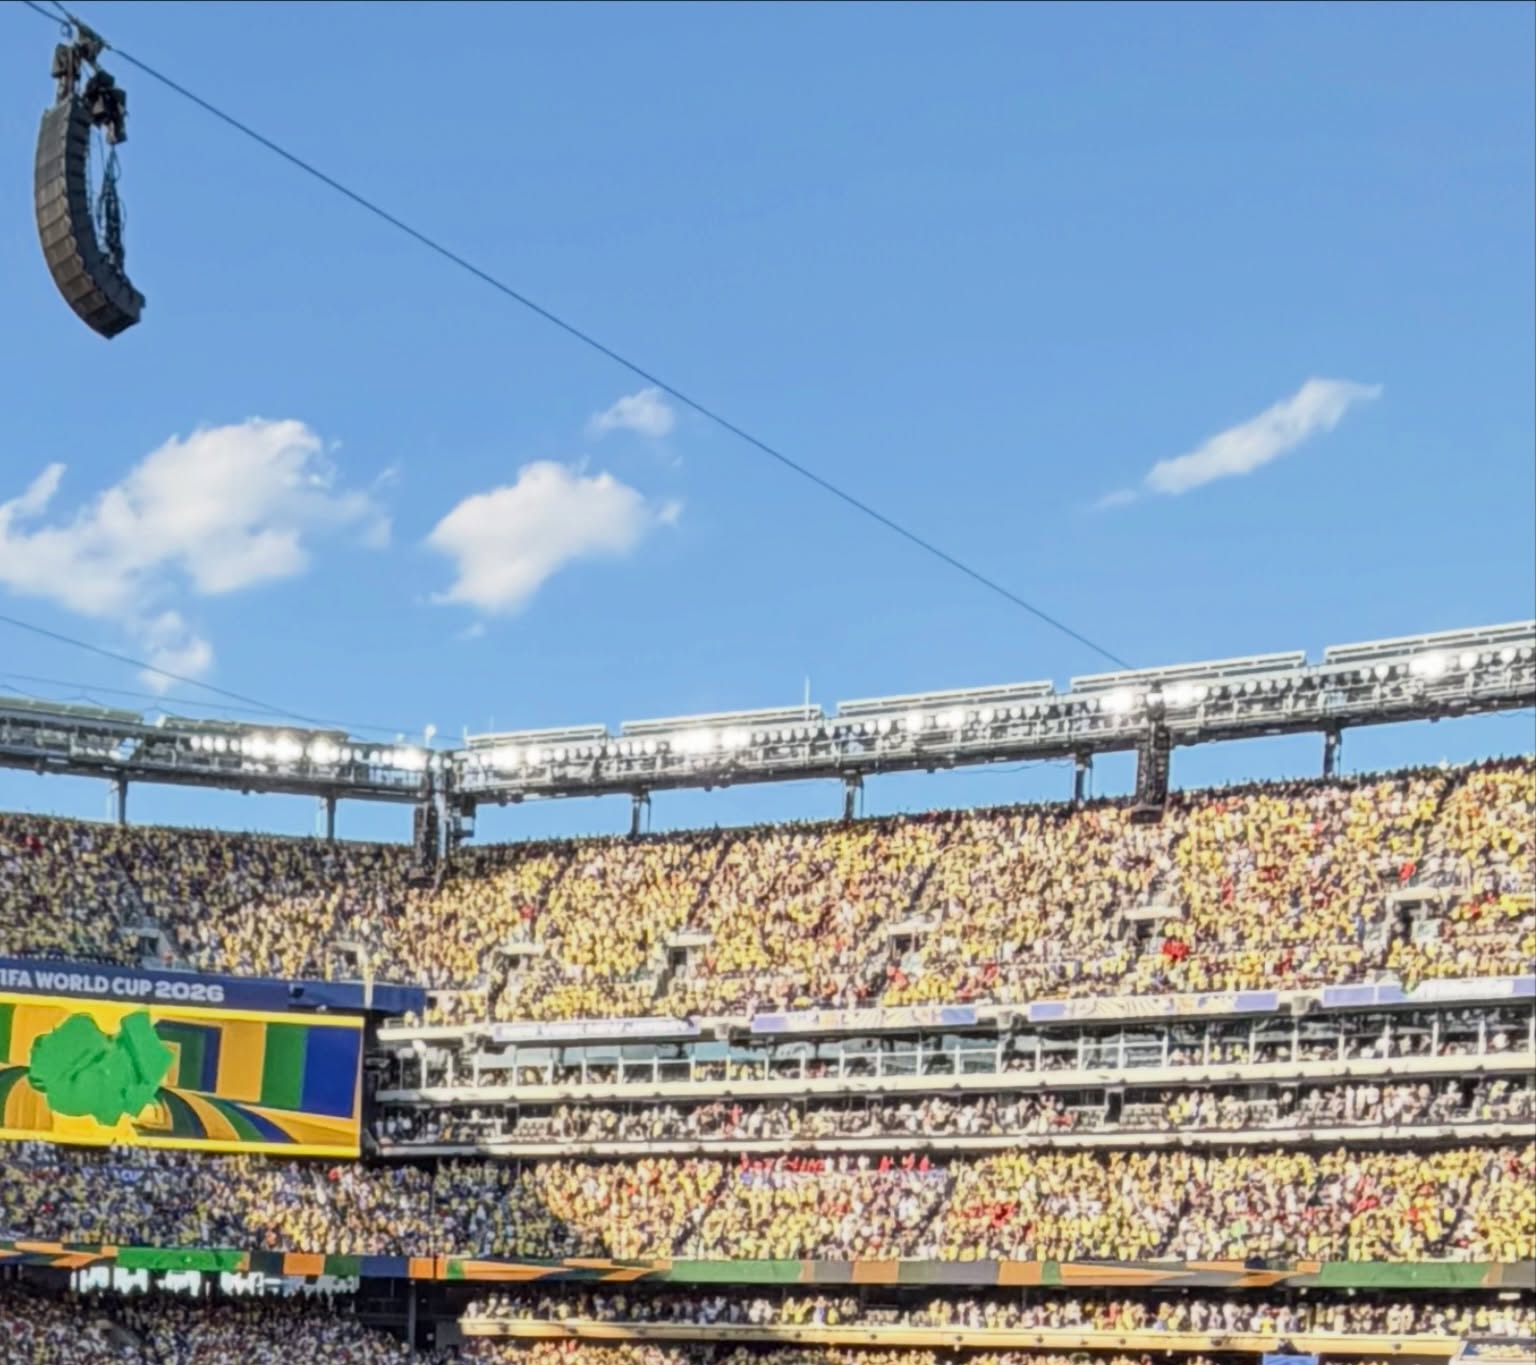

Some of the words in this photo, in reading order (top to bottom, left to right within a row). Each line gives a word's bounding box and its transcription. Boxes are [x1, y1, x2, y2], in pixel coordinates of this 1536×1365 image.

[35, 971, 109, 993] WORLD
[112, 977, 153, 996] CUP
[154, 981, 224, 1002] 2026
